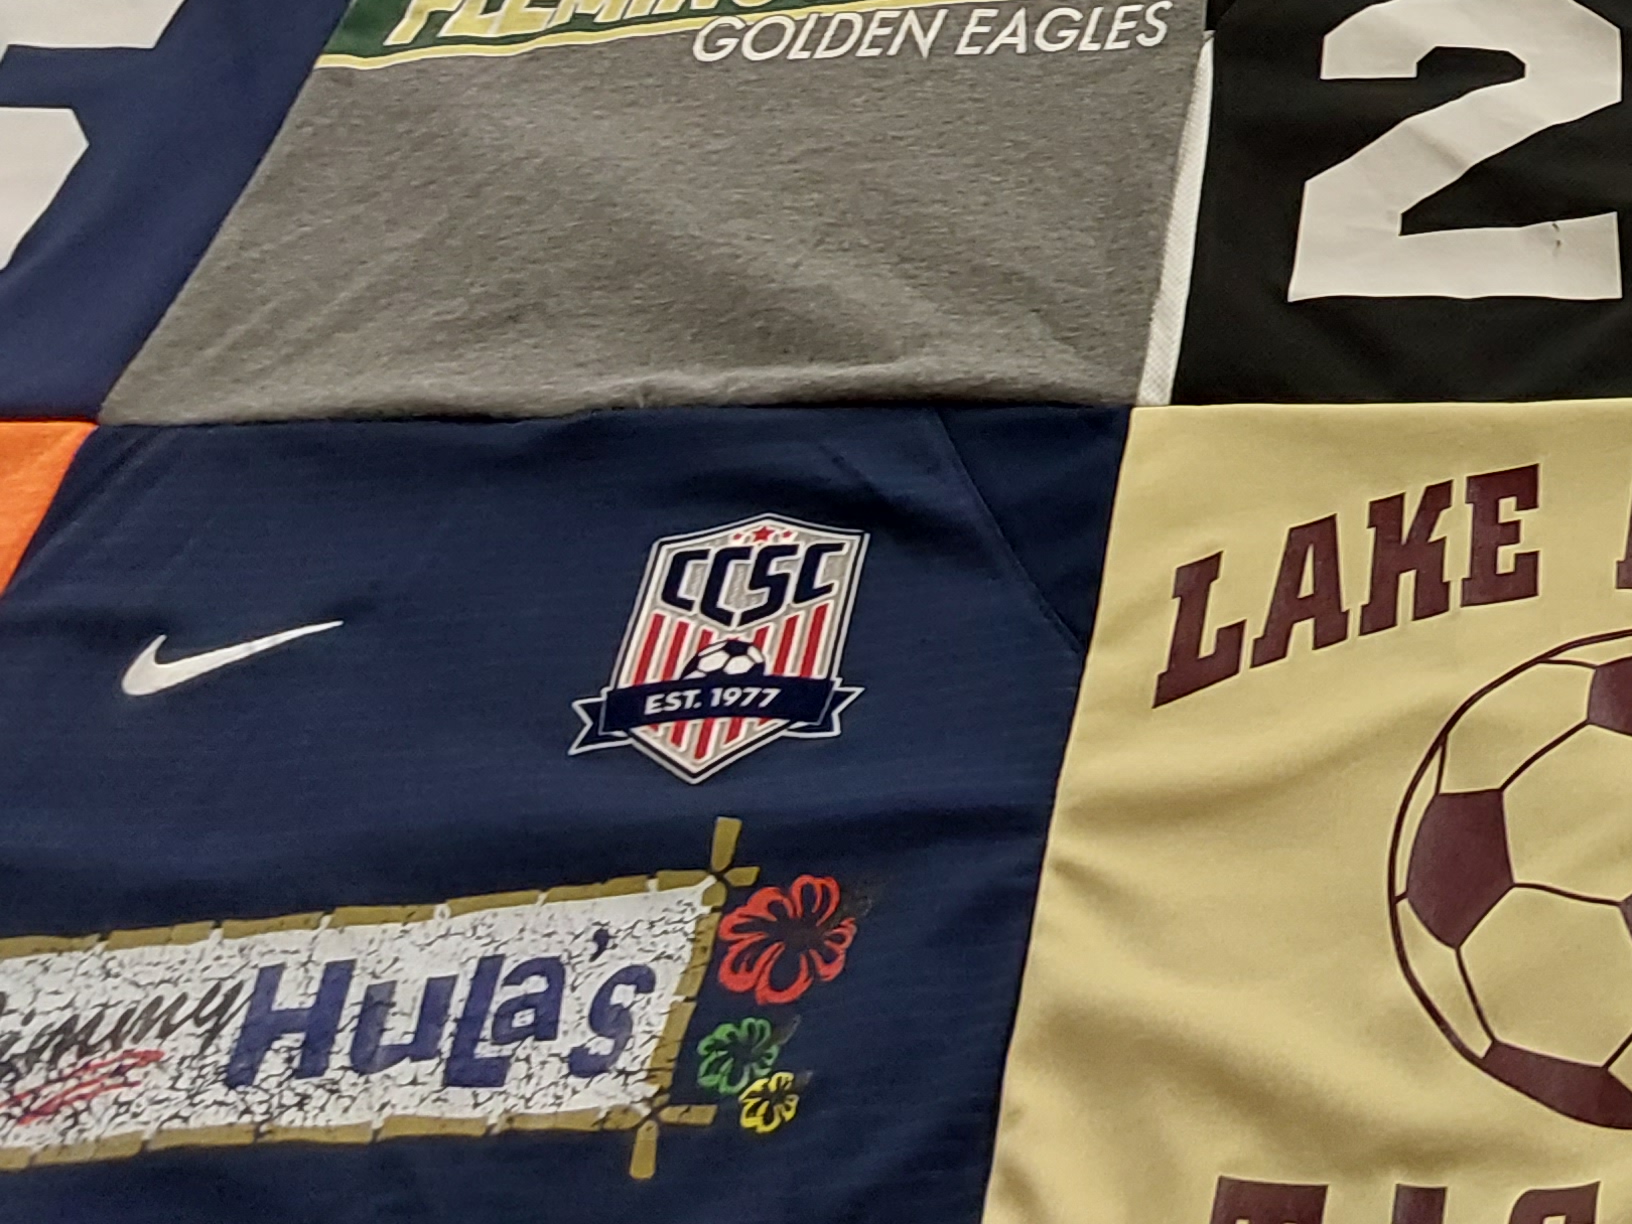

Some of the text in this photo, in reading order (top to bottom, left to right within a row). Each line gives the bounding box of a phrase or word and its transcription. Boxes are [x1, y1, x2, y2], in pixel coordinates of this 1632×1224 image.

[692, 0, 1175, 63] GOLDEN EAGLES
[661, 541, 847, 627] CCSC
[1153, 464, 1541, 707] LAKE
[643, 687, 782, 715] EST. 1977
